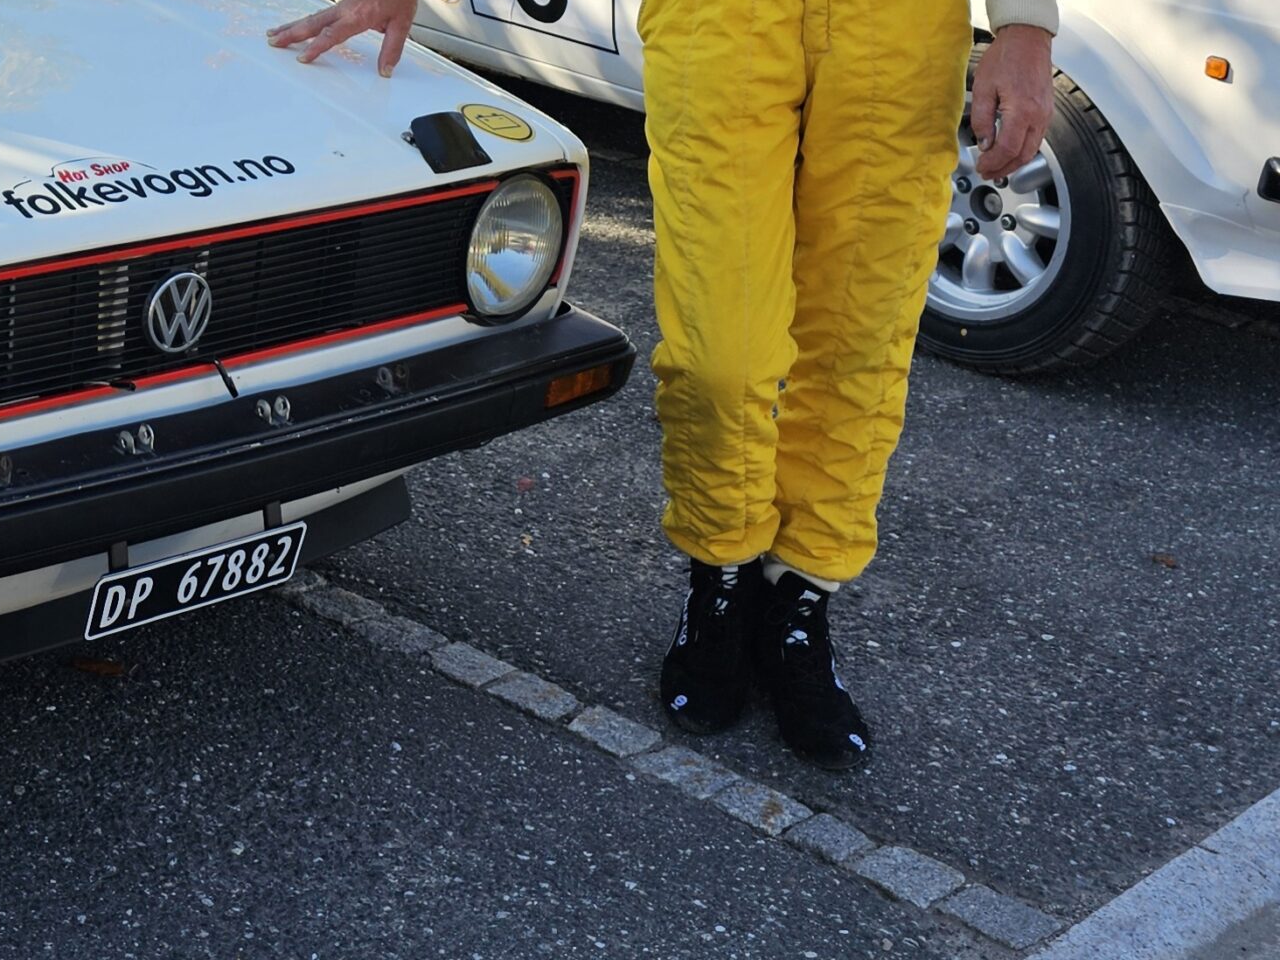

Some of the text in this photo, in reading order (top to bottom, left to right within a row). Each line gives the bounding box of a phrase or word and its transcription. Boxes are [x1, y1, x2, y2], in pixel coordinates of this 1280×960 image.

[1, 155, 296, 218] folkevogn.no
[57, 161, 130, 183] HOT SHOP
[99, 536, 293, 628] DP 67882
